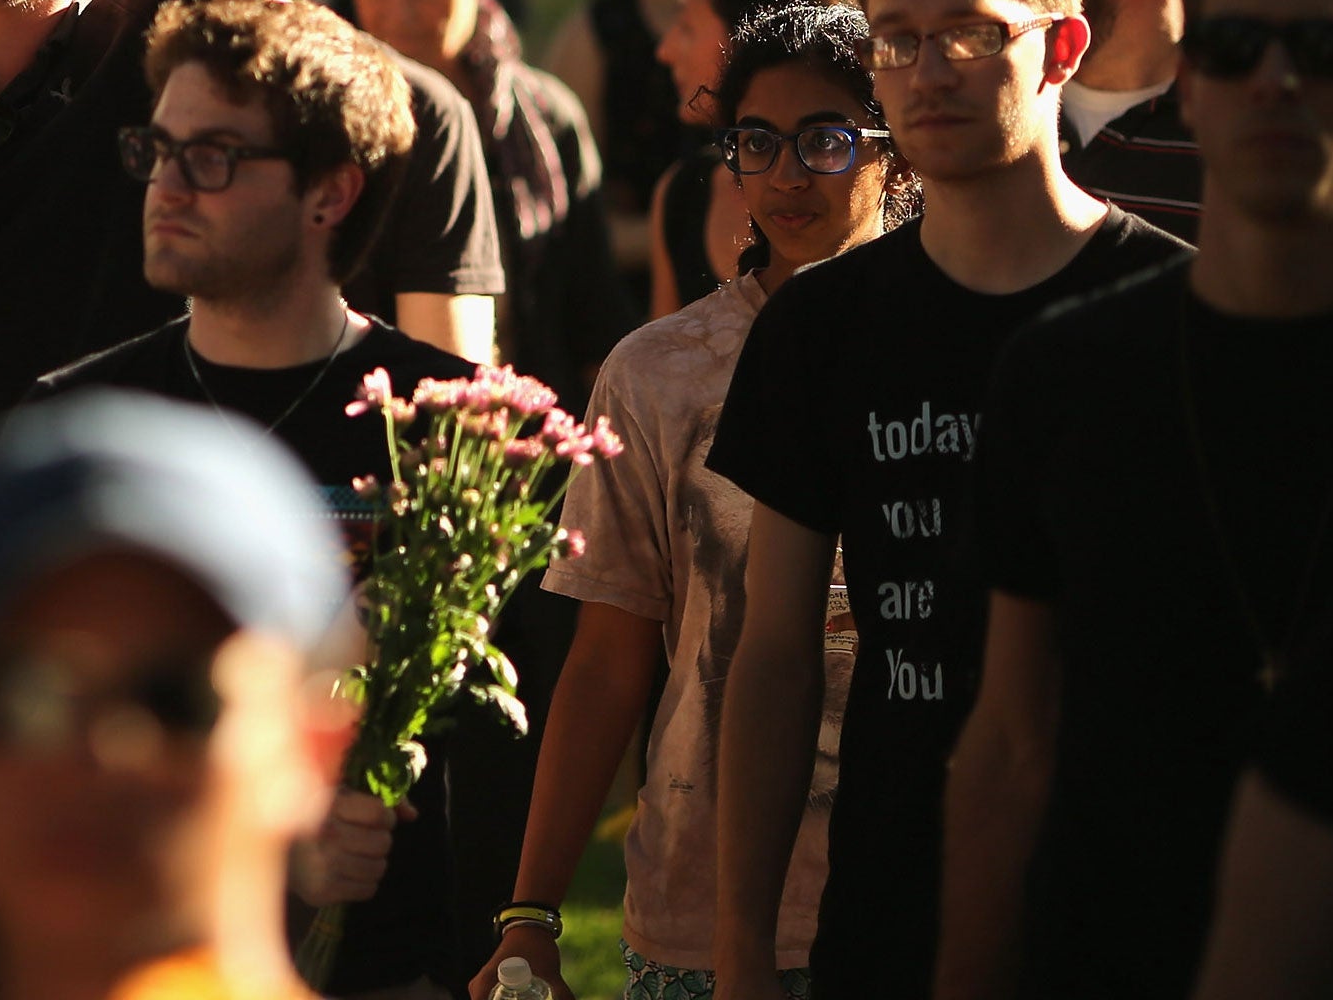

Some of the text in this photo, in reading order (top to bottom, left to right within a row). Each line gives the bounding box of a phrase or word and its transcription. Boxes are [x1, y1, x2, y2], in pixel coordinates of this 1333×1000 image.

[867, 400, 983, 462] today
[877, 579, 935, 620] are
[885, 648, 944, 701] You
